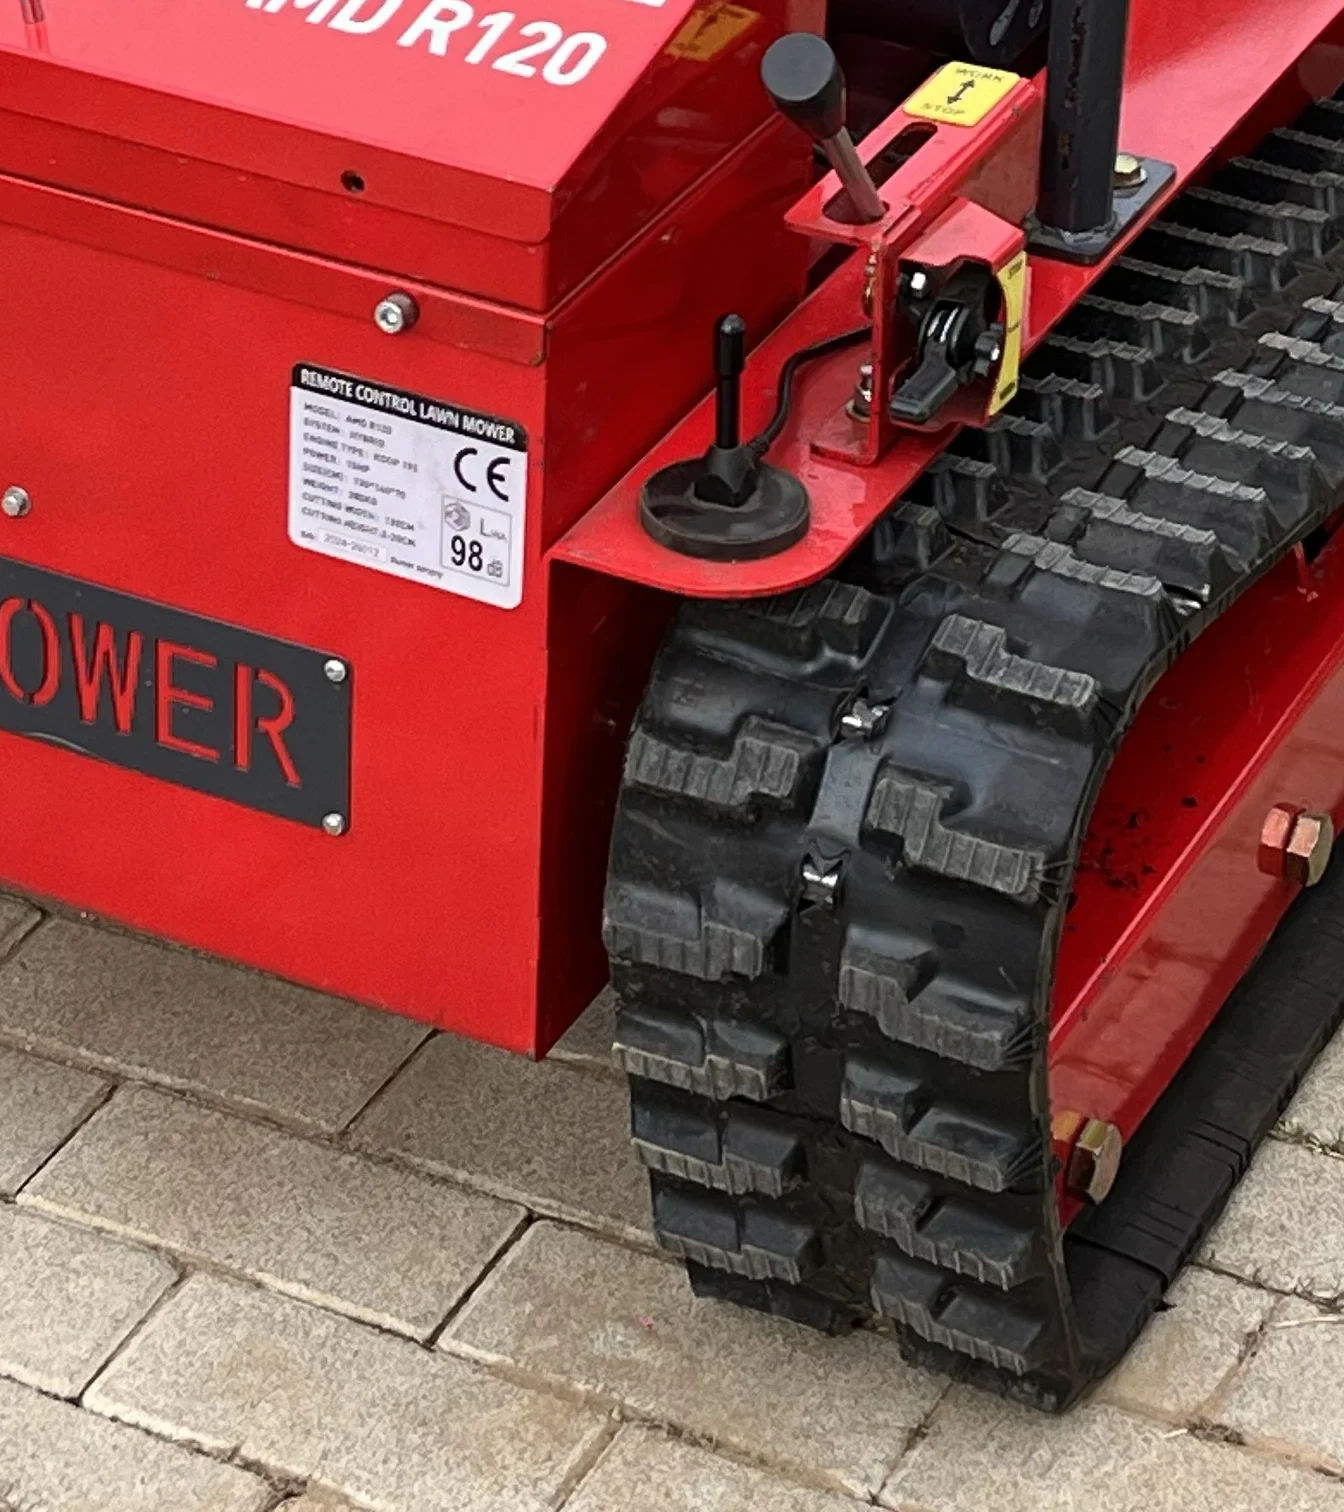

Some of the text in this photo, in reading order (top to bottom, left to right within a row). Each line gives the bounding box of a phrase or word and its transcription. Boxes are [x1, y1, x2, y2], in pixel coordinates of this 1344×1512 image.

[300, 368, 517, 445] REMOTE CONTROL LAWN MOWER
[450, 534, 484, 572] 98
